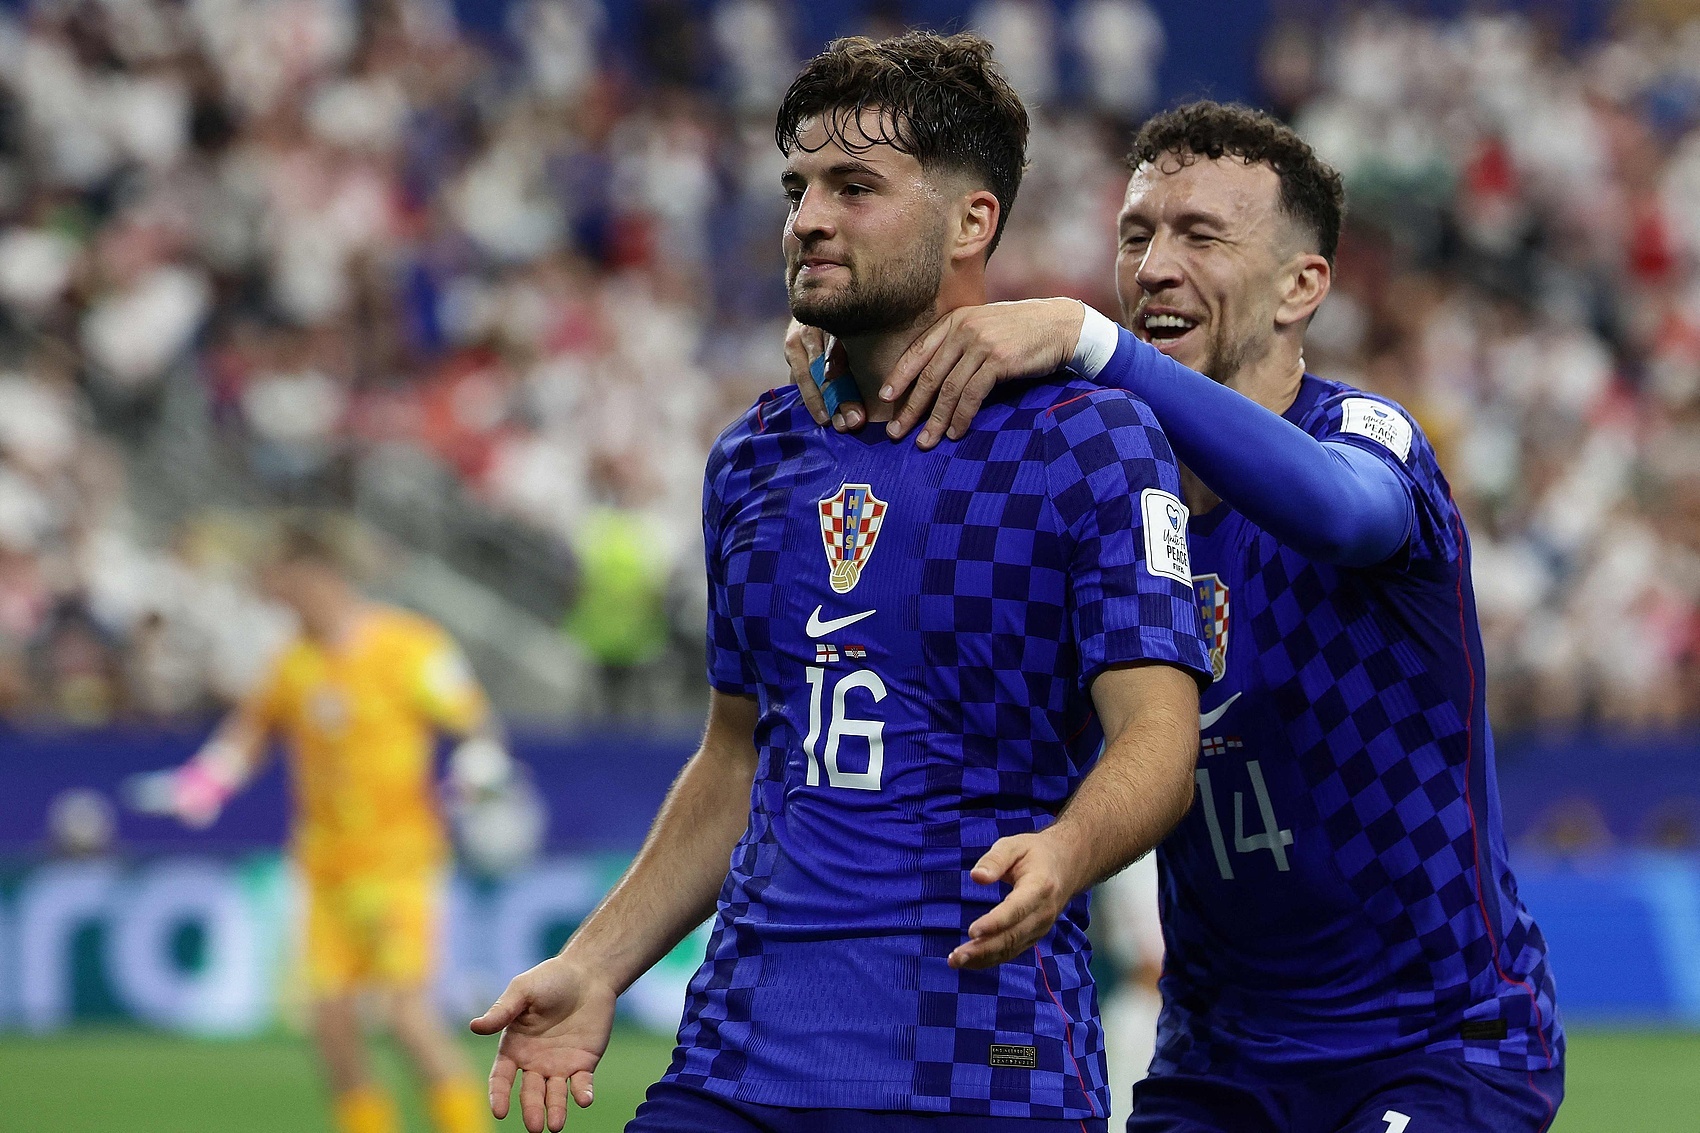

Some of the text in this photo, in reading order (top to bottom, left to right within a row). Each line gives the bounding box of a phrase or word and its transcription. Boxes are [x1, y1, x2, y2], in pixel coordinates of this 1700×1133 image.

[845, 496, 860, 550] HNS
[1166, 545, 1189, 568] PEACE
[1200, 586, 1214, 639] HNS
[803, 666, 887, 791] 16
[1196, 760, 1294, 880] 14
